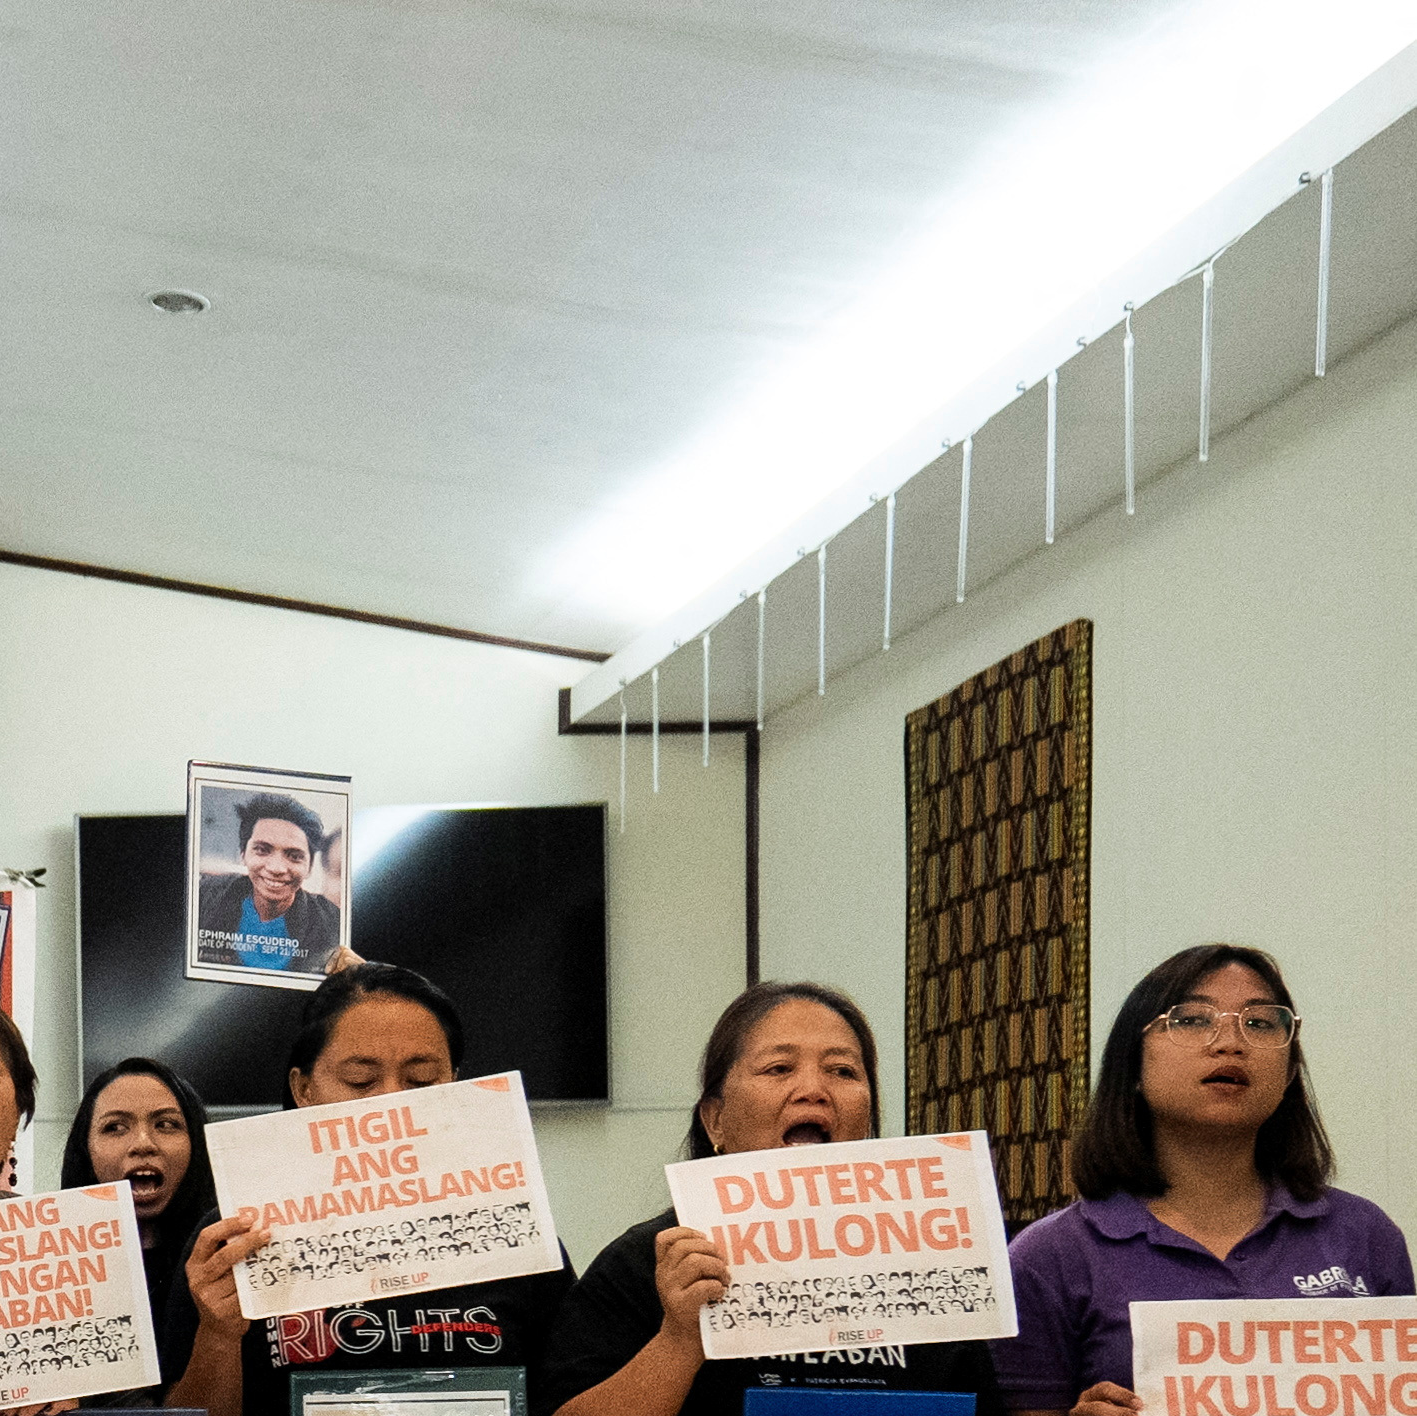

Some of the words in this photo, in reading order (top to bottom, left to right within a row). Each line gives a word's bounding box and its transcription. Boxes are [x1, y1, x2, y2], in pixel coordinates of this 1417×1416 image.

[199, 929, 243, 942] EPHRAIM
[246, 935, 299, 948] ESCUDERO
[308, 1106, 428, 1153] ITIGIL
[333, 1145, 419, 1186] ANG
[713, 1157, 948, 1215] DUTERTE
[236, 1161, 526, 1228] PAMAMASLANG!
[711, 1207, 973, 1266] IKULONG!
[380, 1275, 409, 1288] RISE
[411, 1272, 429, 1285] UP
[277, 1306, 502, 1364] RIGHTS
[411, 1322, 501, 1335] DEFENDERS
[838, 1331, 865, 1342] RISE
[867, 1329, 883, 1340] UP
[1177, 1319, 1417, 1364] DUTERTE
[11, 1388, 29, 1399] UP
